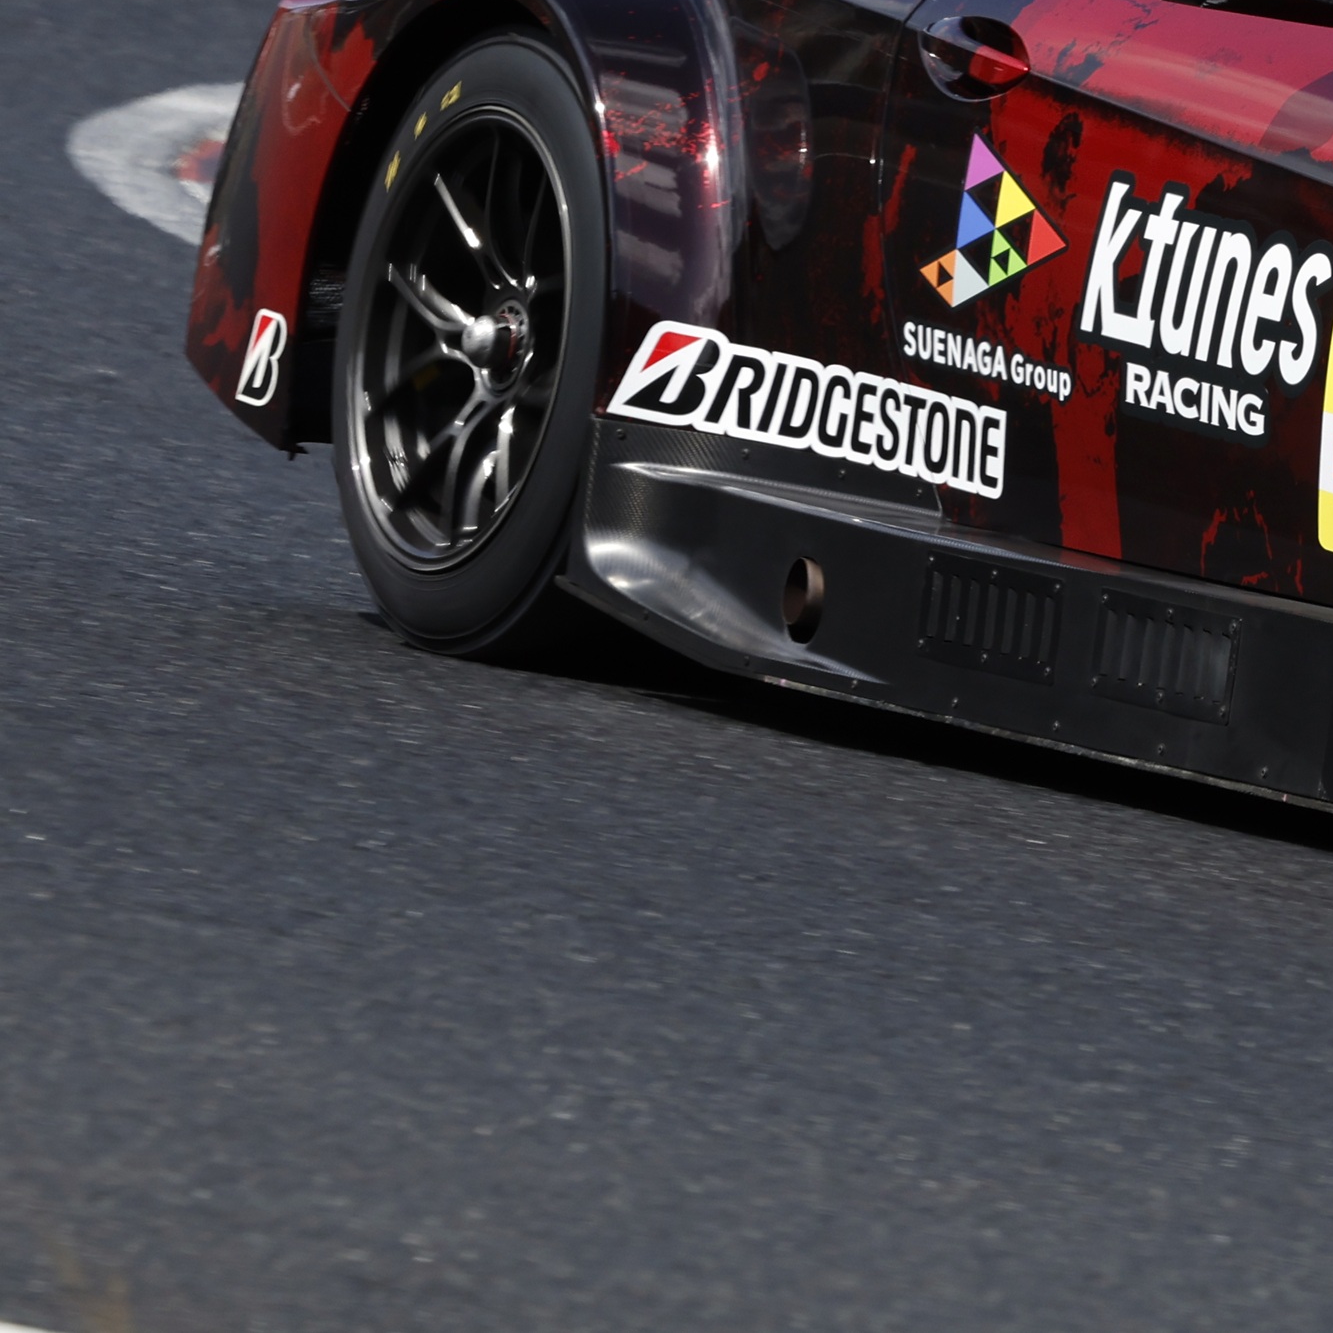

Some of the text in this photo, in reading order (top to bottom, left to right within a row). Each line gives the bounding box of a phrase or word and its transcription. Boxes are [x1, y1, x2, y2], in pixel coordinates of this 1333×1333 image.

[903, 321, 1071, 401] SUENAGA Group
[1125, 362, 1265, 436] RACING
[624, 331, 1000, 487] BRIDGESTONE
